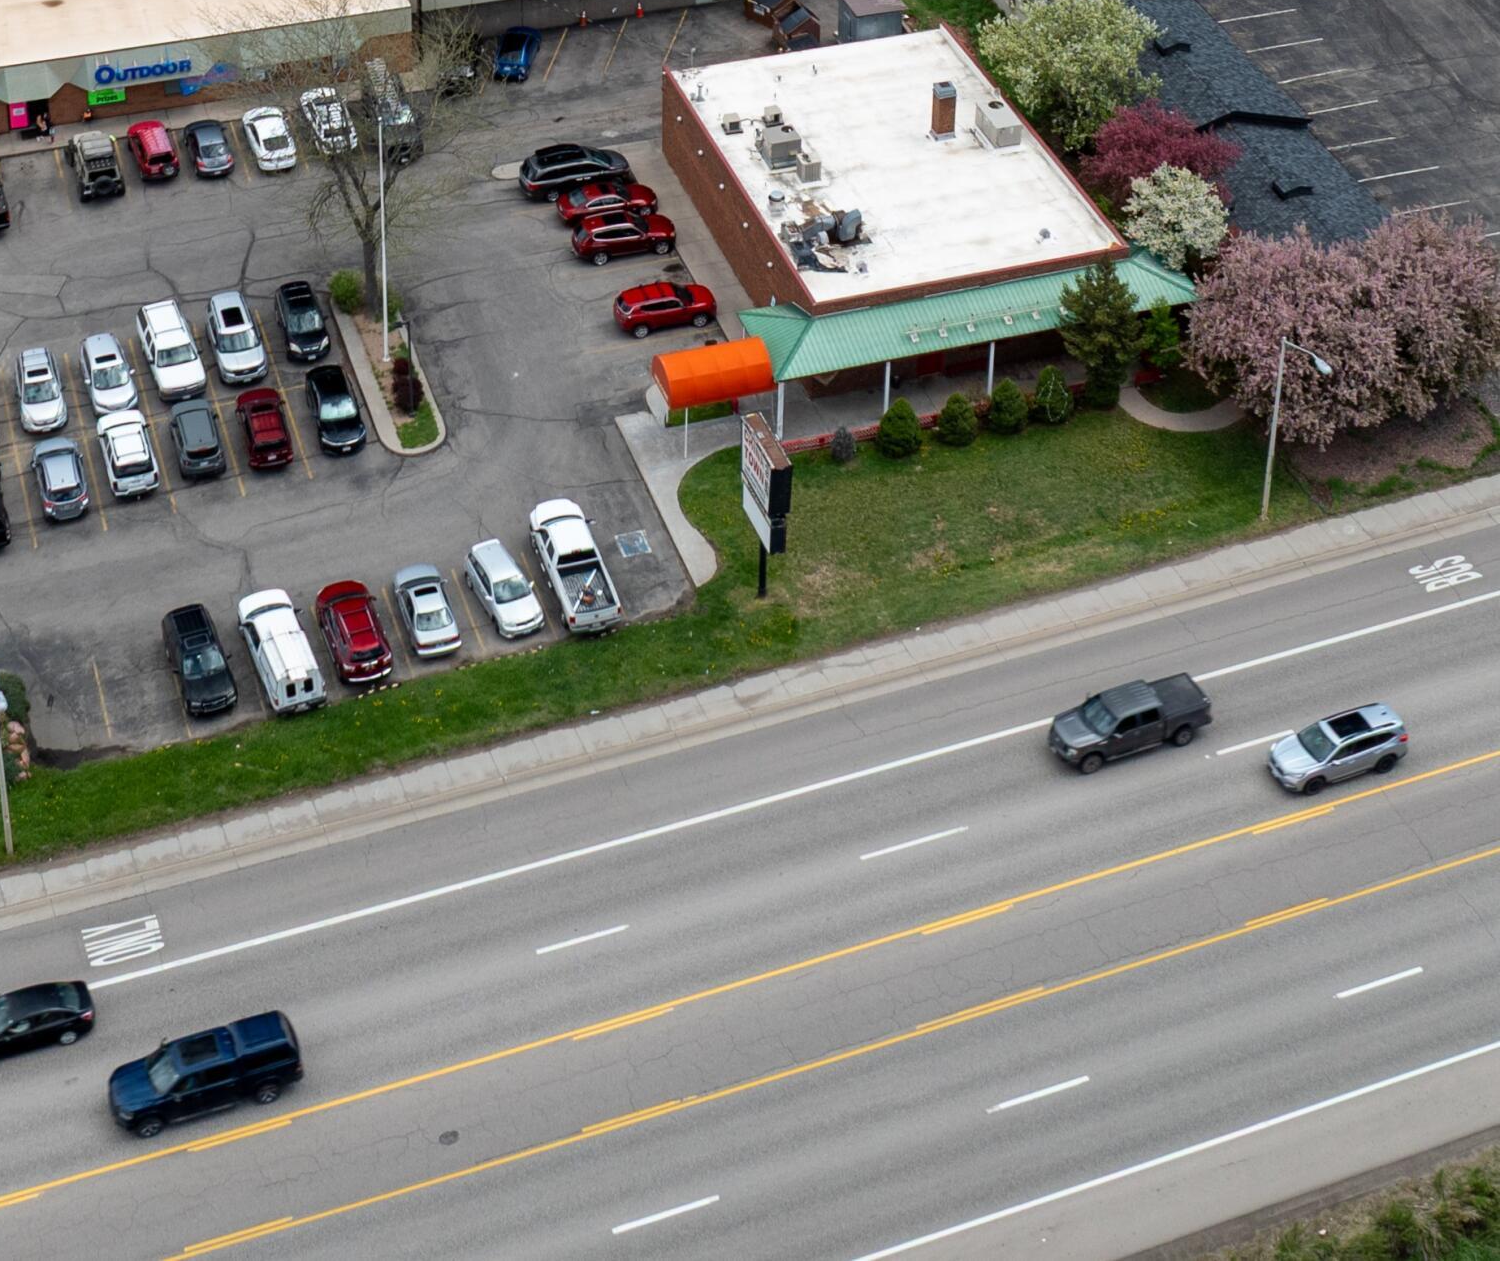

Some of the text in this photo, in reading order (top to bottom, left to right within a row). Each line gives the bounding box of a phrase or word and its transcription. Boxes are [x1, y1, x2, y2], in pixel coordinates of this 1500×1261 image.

[95, 59, 192, 84] OUTDOOR
[1408, 555, 1483, 593] BUS
[81, 914, 165, 967] ONLY
